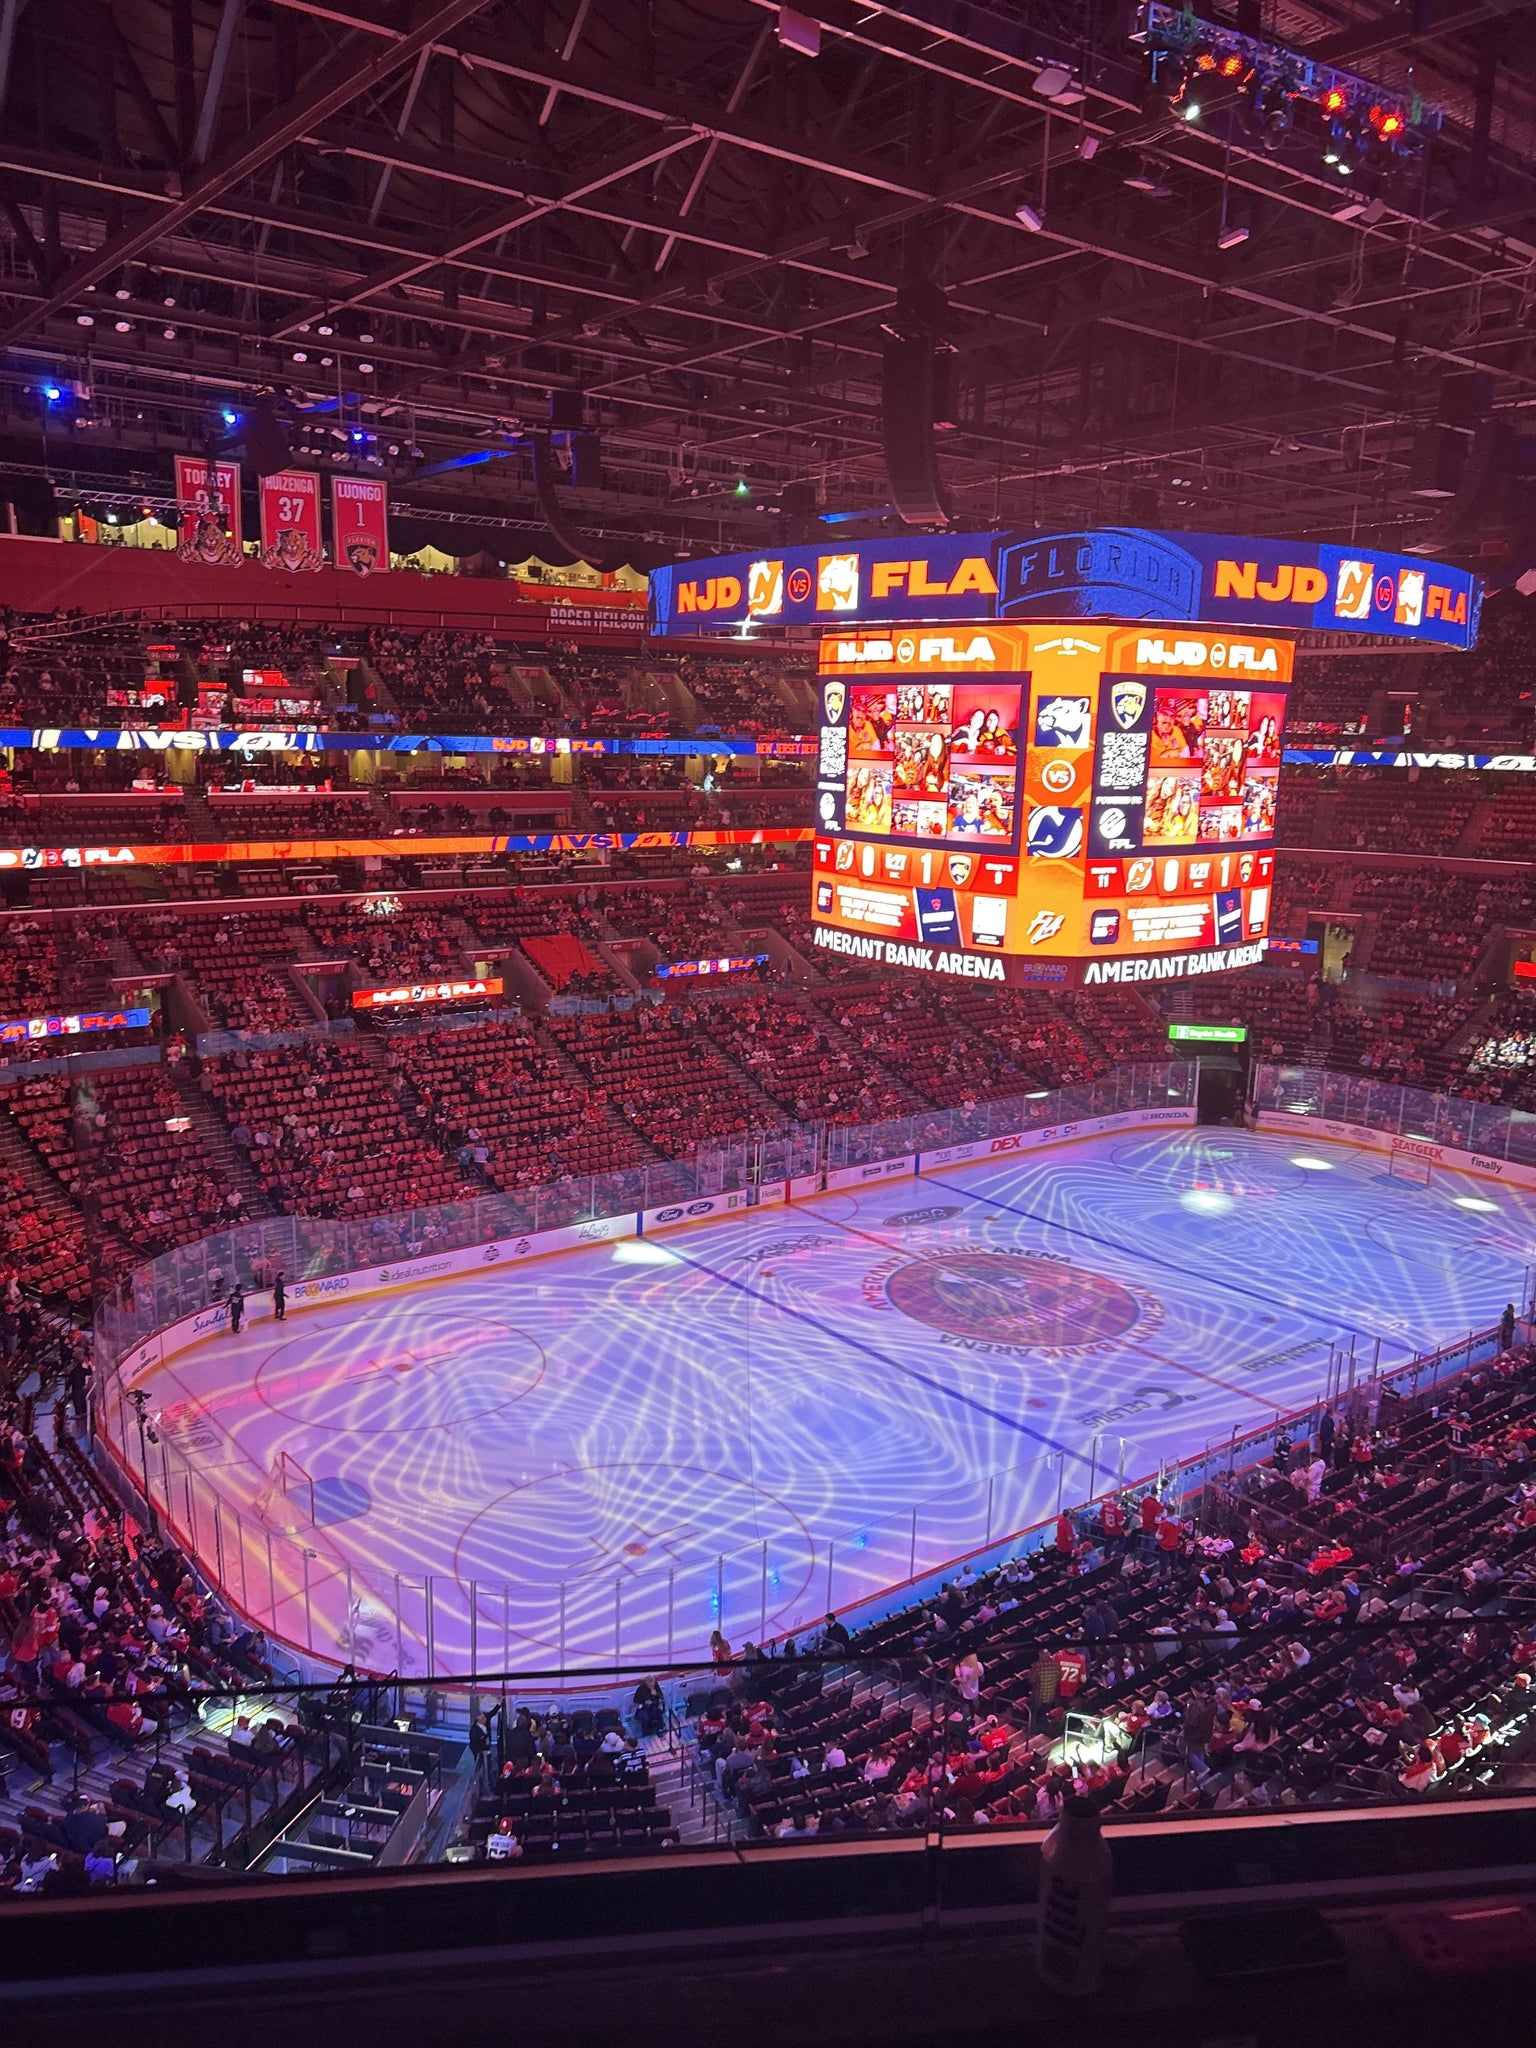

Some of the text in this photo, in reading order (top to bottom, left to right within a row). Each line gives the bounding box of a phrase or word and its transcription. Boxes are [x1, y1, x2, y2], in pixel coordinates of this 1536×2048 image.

[265, 476, 314, 494] HUIZENGA
[338, 483, 381, 501] LUONGO
[279, 497, 304, 522] 37
[356, 503, 365, 526] 1
[678, 558, 999, 613] NJD VS FLA
[1215, 561, 1328, 604] NJD
[1426, 586, 1466, 624] FLA
[550, 608, 591, 626] ROGER
[838, 641, 894, 662] NJD
[920, 637, 995, 662] FLA
[1137, 639, 1207, 665] NJD
[1228, 645, 1277, 671] FLA
[138, 732, 207, 749] VS
[492, 739, 605, 751] NJD FLA
[756, 743, 818, 754] NEW JERSEY DEVI
[1412, 753, 1465, 768] VS
[1050, 769, 1069, 783] VS
[567, 835, 613, 848] VS
[85, 849, 135, 862] FLA
[921, 852, 932, 884] 1
[1221, 856, 1230, 887] 1
[814, 927, 1005, 981] AMERANT BANK ARENA
[1270, 940, 1303, 951] FLA
[669, 964, 697, 975] NJD
[1084, 945, 1263, 985] AMERANT BANK ARENA
[373, 983, 487, 1003] NJD FLA
[83, 1014, 127, 1028] FLA
[1064, 1125, 1078, 1133] CH
[991, 1136, 1022, 1153] DEX
[1392, 1138, 1444, 1160] SEATGEEK
[1471, 1156, 1503, 1173] finally
[762, 1188, 781, 1198] Health
[660, 1210, 680, 1221] Ford
[690, 1203, 712, 1214] Ford
[862, 1245, 1073, 1311] AMERANT BANK ARENA
[193, 1310, 232, 1333] Sandal
[939, 1333, 1032, 1357] ARENA
[1039, 1341, 1119, 1358] BANK
[1082, 1400, 1151, 1428] CELSIUS
[1061, 1667, 1079, 1682] 72
